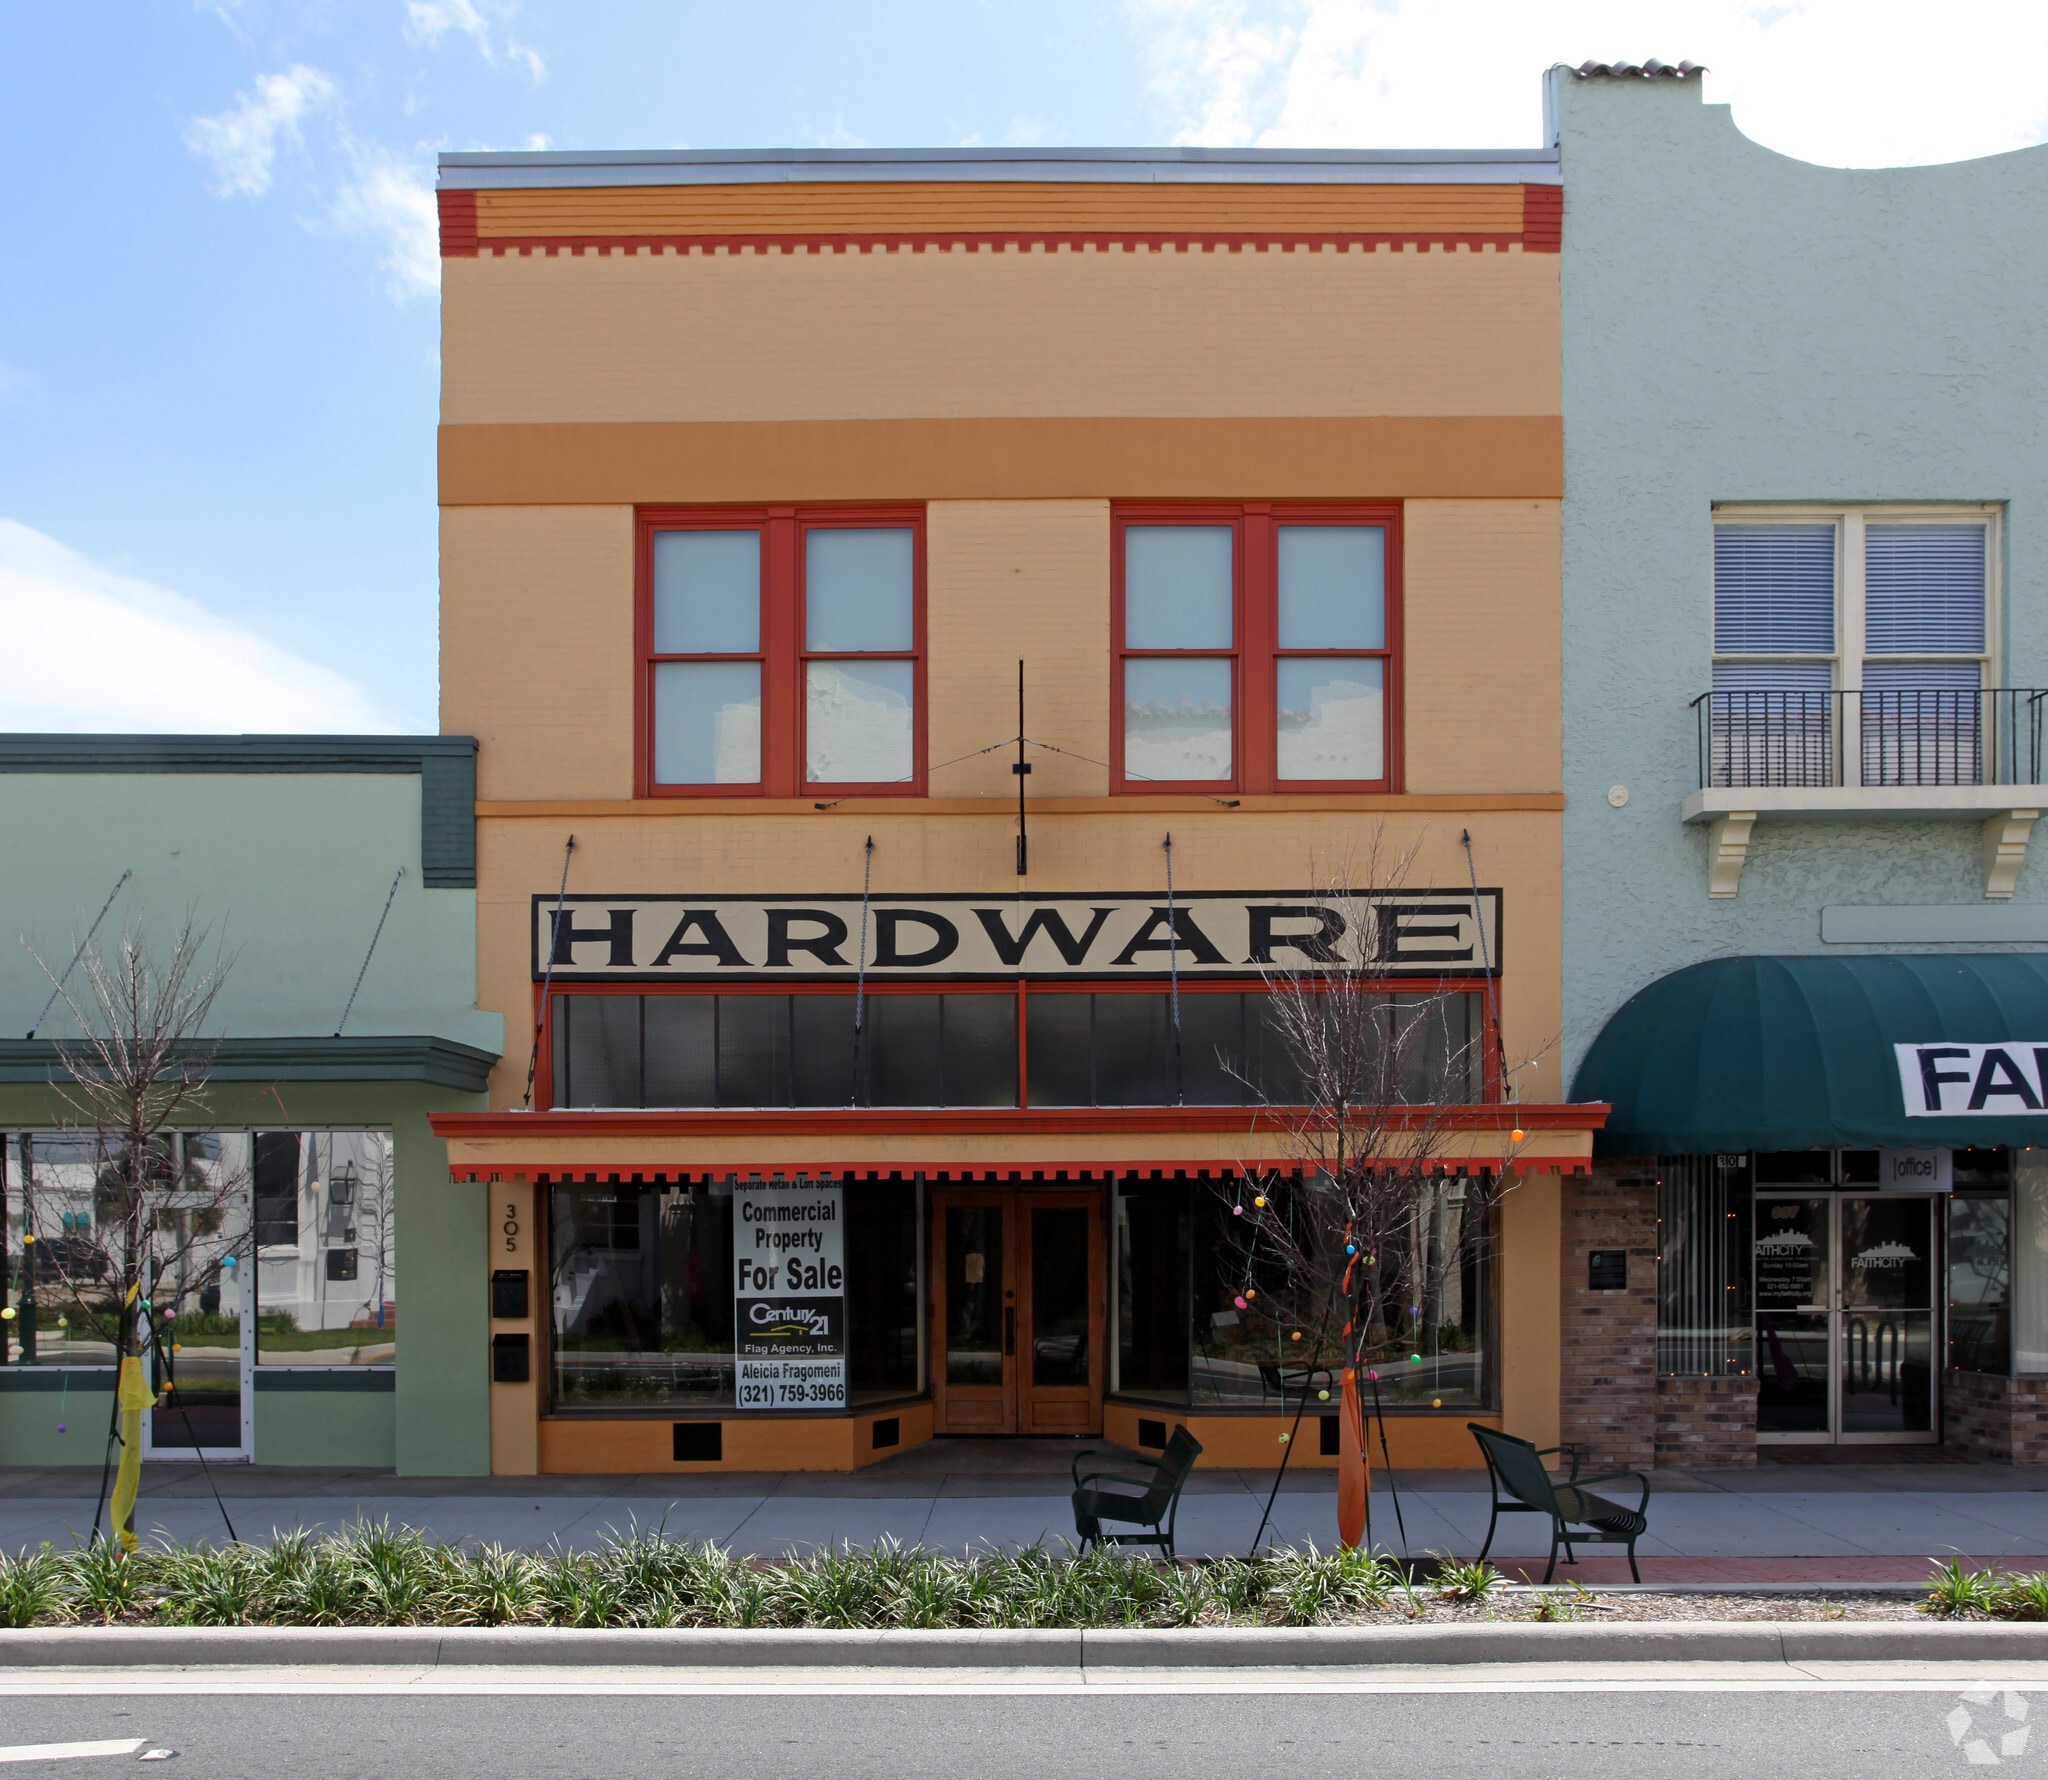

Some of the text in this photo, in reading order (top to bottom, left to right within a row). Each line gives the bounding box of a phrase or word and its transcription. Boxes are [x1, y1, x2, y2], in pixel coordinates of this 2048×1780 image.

[548, 903, 1474, 966] HARDWARE
[735, 1179, 767, 1192] Separate
[816, 1180, 842, 1191] Spaces
[743, 1200, 835, 1222] Commercial
[503, 1204, 518, 1252] 305
[756, 1227, 823, 1253] Property
[1756, 1245, 1803, 1256] AITHCITY
[739, 1257, 842, 1291] For Sale
[1851, 1257, 1905, 1268] FAITHCITY
[749, 1303, 829, 1335] Century 21
[745, 1343, 837, 1355] Flag Agency, Inc.
[742, 1362, 841, 1382] Aleicia Fragomeni
[739, 1383, 844, 1407] (321) 759-3966
